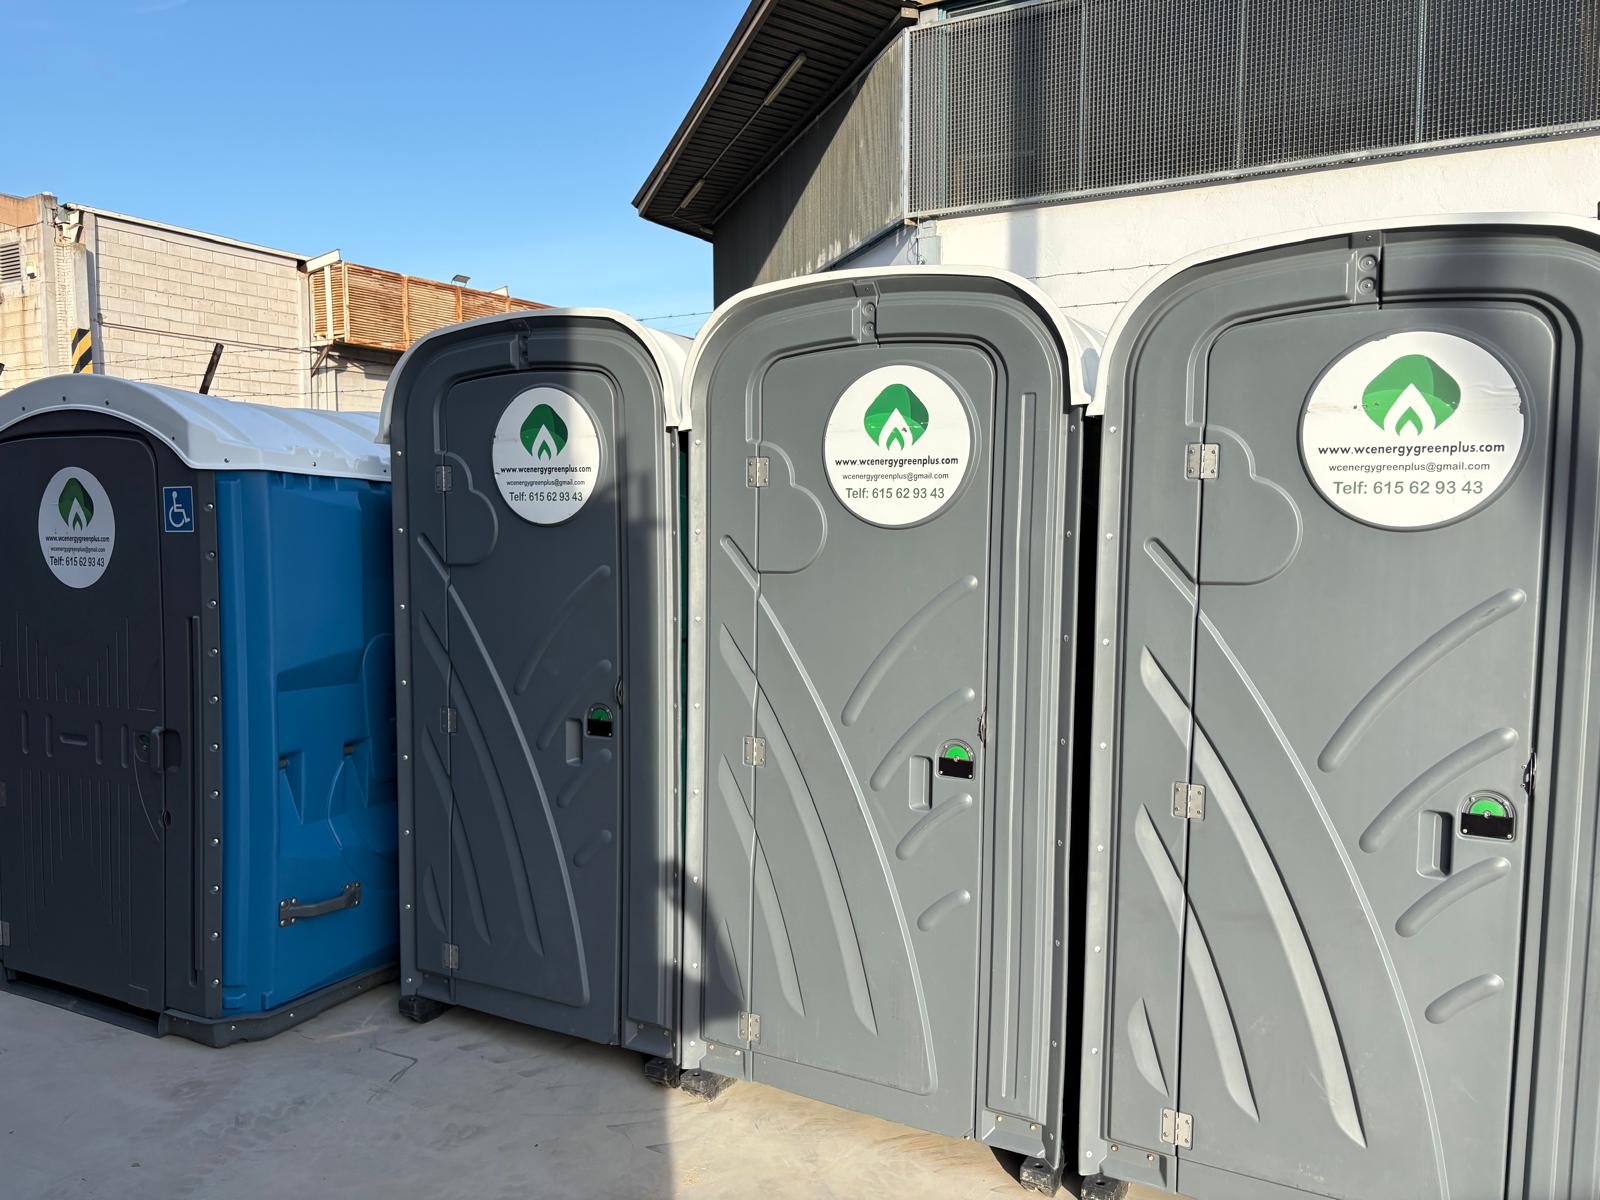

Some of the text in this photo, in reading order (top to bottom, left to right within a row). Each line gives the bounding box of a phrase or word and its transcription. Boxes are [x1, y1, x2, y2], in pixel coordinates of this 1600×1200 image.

[1318, 441, 1505, 457] www.wcenergygreenplus.com
[835, 455, 959, 468] www.wcenergygreenplus.com
[500, 464, 592, 475] www.wcenergygreenplus.com
[1328, 462, 1491, 474] wcenergygreenplus@gmail.com
[842, 472, 949, 482] wcenergygreenplus@gmail.com
[506, 479, 586, 487] wcenergygreenplus@gmail.com
[1333, 480, 1484, 495] Telf: 615 62 93 43
[509, 492, 583, 501] Telf: 615 62 93 43
[845, 487, 945, 499] Telf: 615 62 93 43
[45, 535, 110, 543] www.wcenergygreenplus.com
[49, 556, 105, 567] Telf: 615 62 93 43
